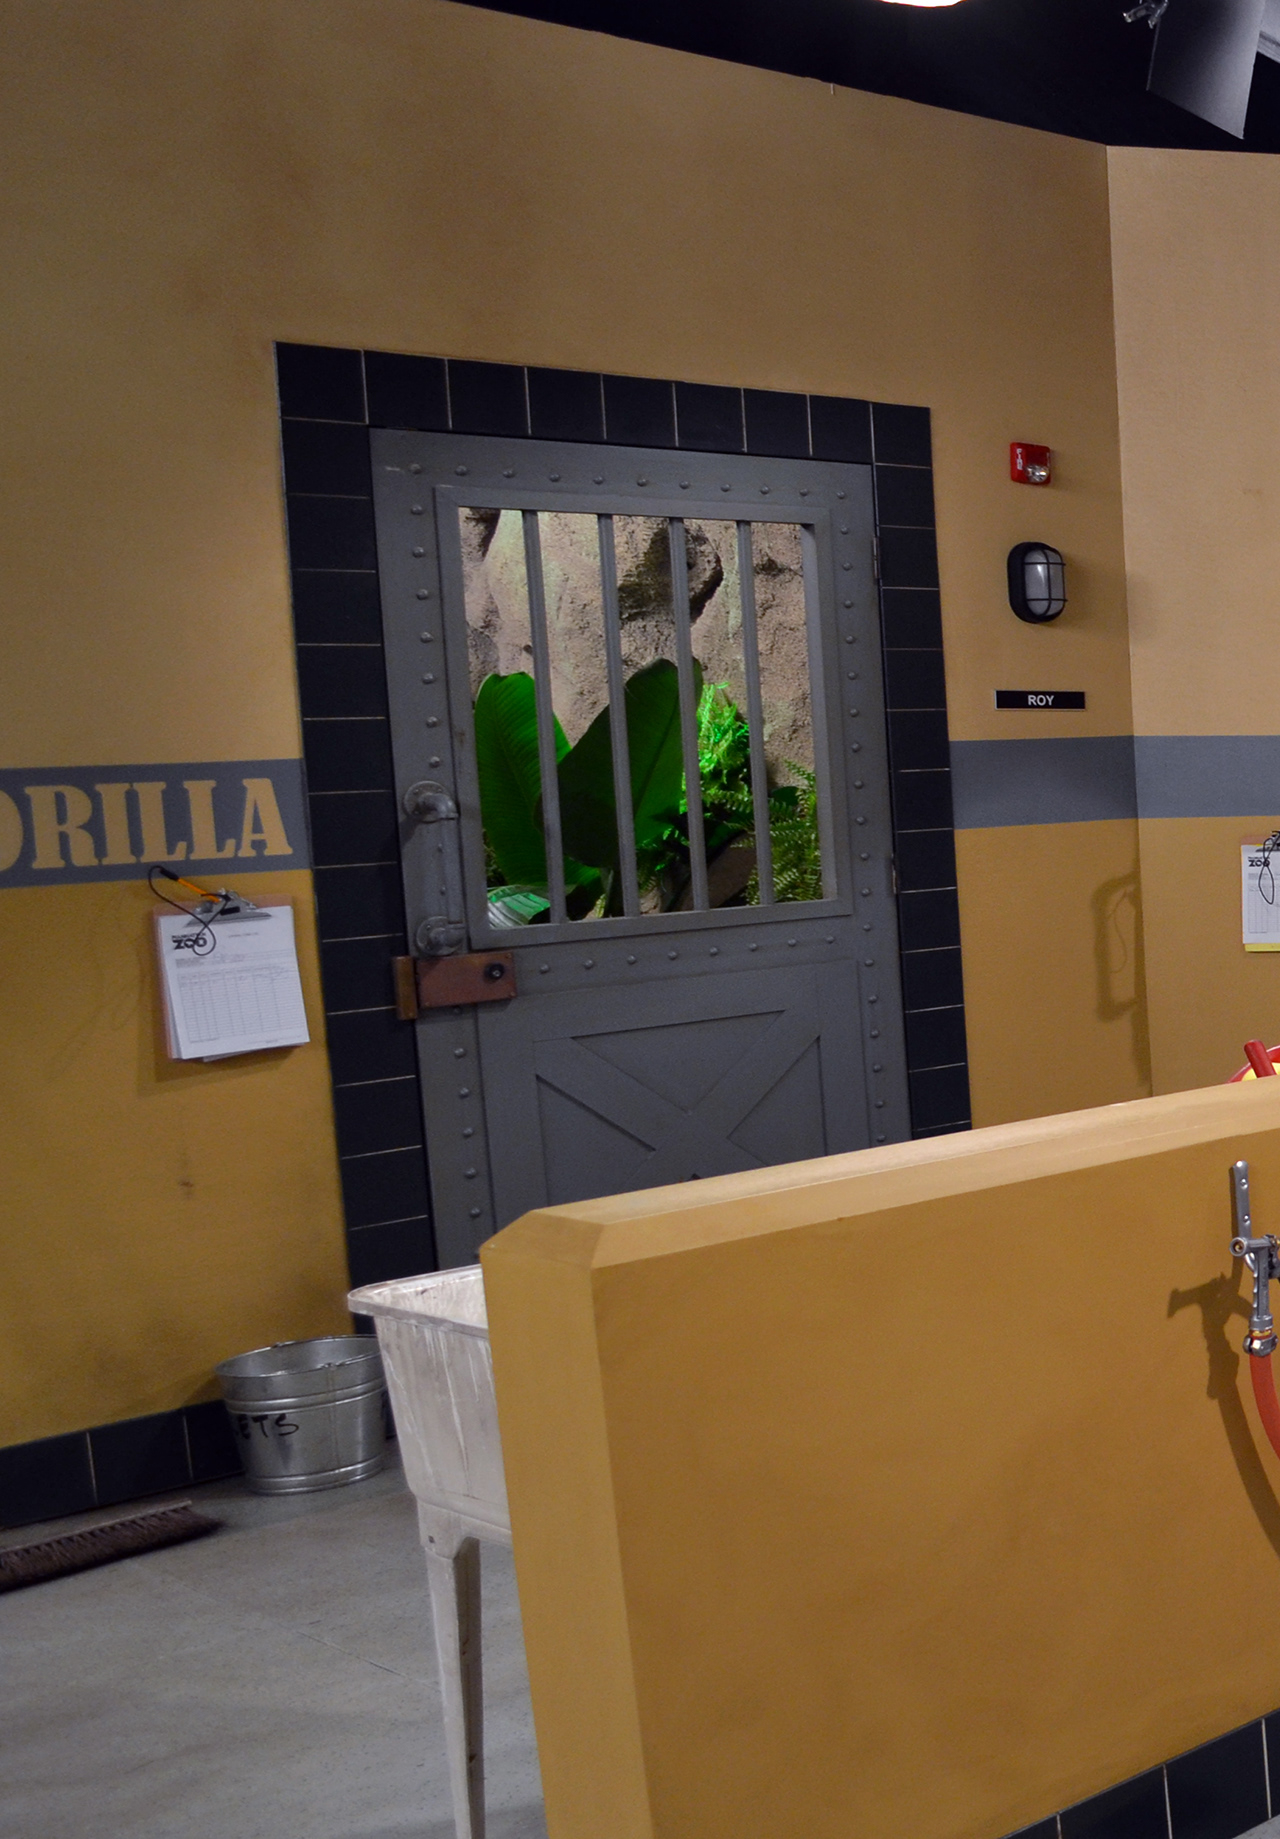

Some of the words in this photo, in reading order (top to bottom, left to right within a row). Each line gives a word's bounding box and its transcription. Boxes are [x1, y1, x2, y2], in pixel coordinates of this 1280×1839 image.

[1027, 694, 1054, 706] ROY
[172, 937, 207, 950] ZOO
[236, 1413, 299, 1439] ETS
